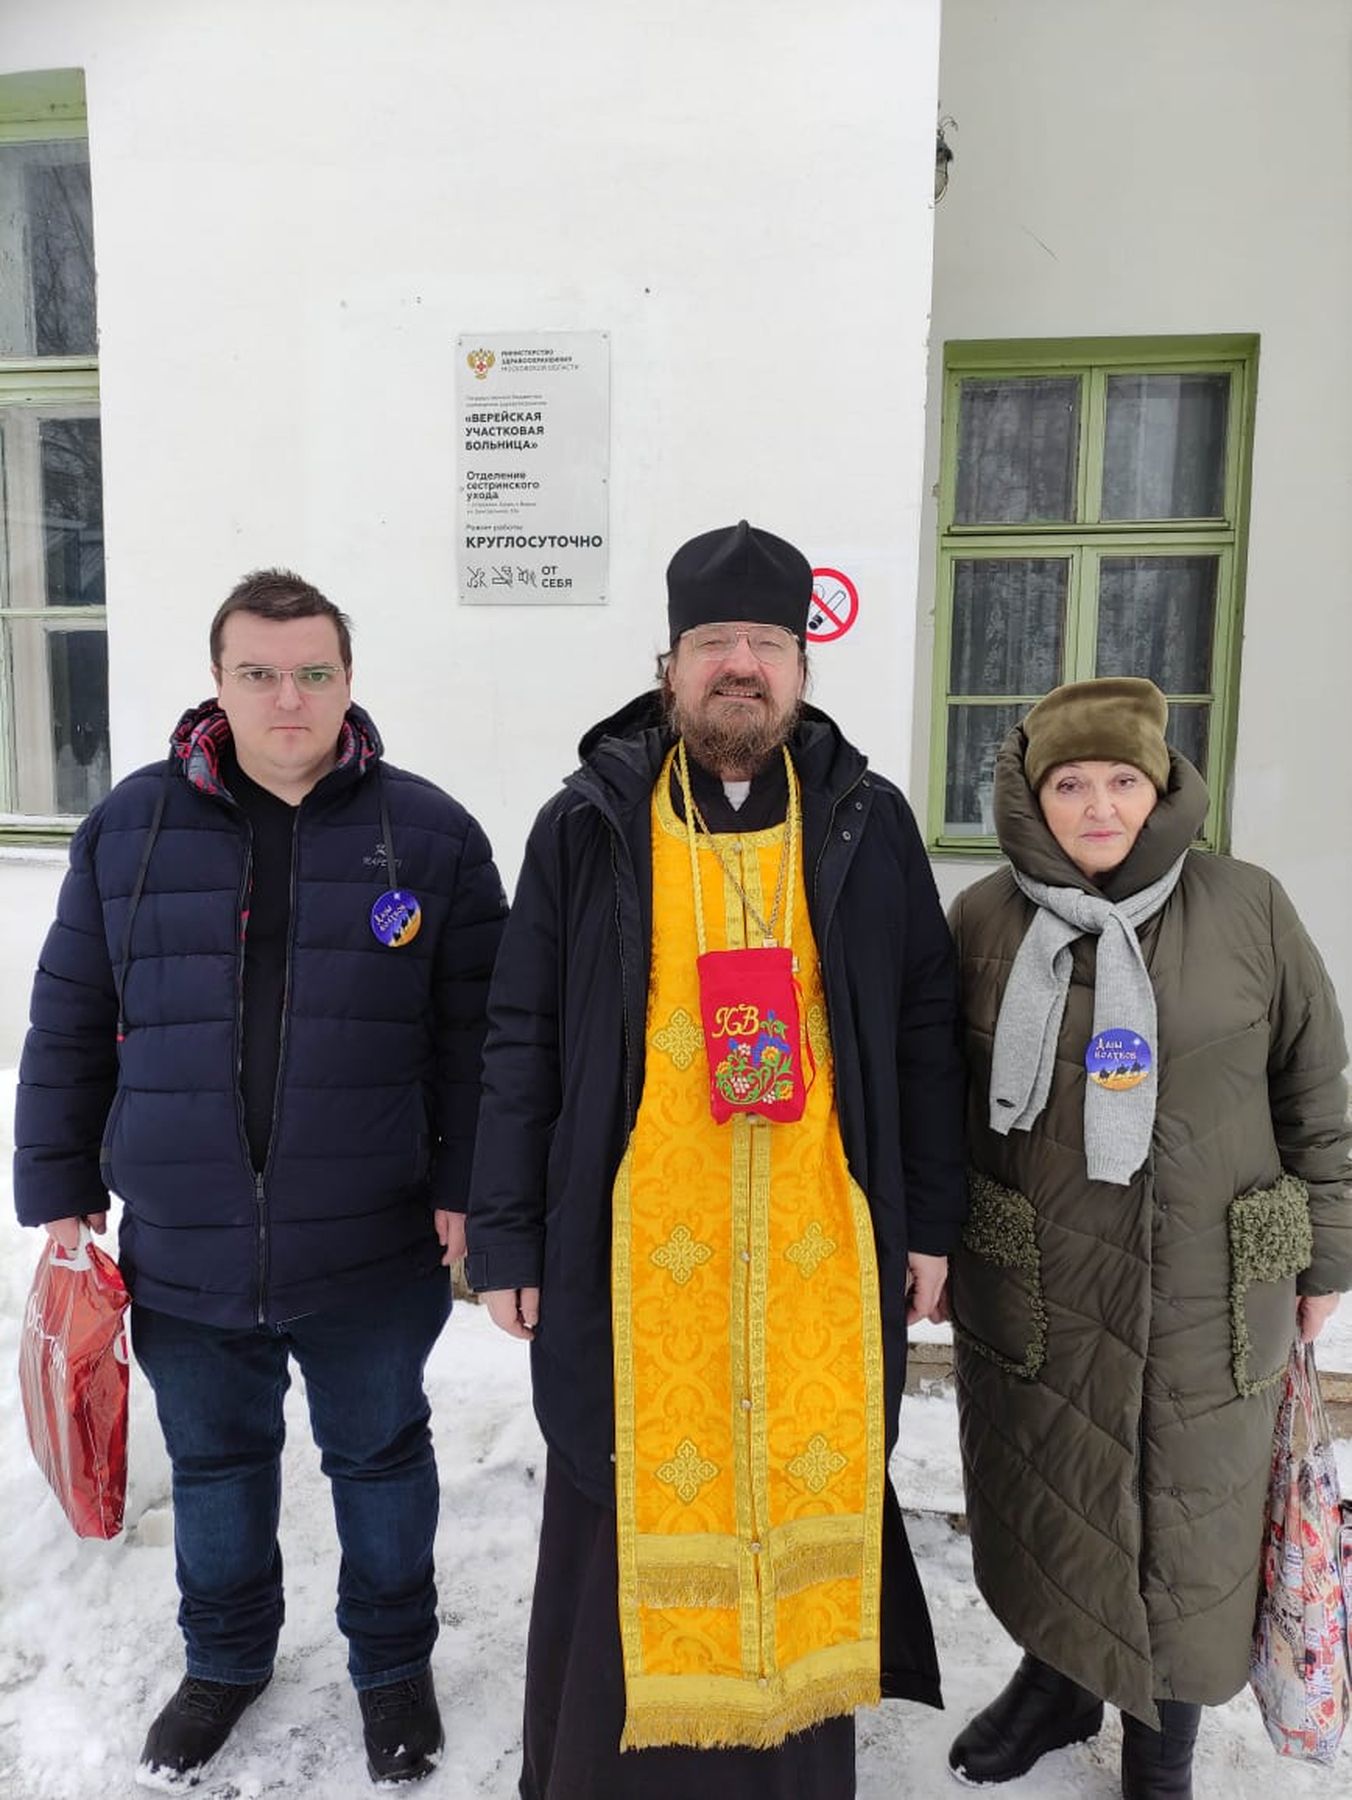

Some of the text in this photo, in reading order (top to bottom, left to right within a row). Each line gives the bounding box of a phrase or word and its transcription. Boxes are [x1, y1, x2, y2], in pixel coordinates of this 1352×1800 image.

[465, 411, 542, 423] «ВЕРЕЙСКАЯ
[465, 426, 545, 437] УЧАСТКОВАЯ
[465, 440, 538, 451] БОЛЬНИЦА»
[466, 470, 527, 481] Отделение
[466, 480, 540, 491] сестринского
[466, 491, 499, 502] ухода
[466, 535, 603, 549] КРУГЛОСУТОЧНО
[541, 565, 559, 576] ОТ
[541, 578, 573, 589] СЕБЯ
